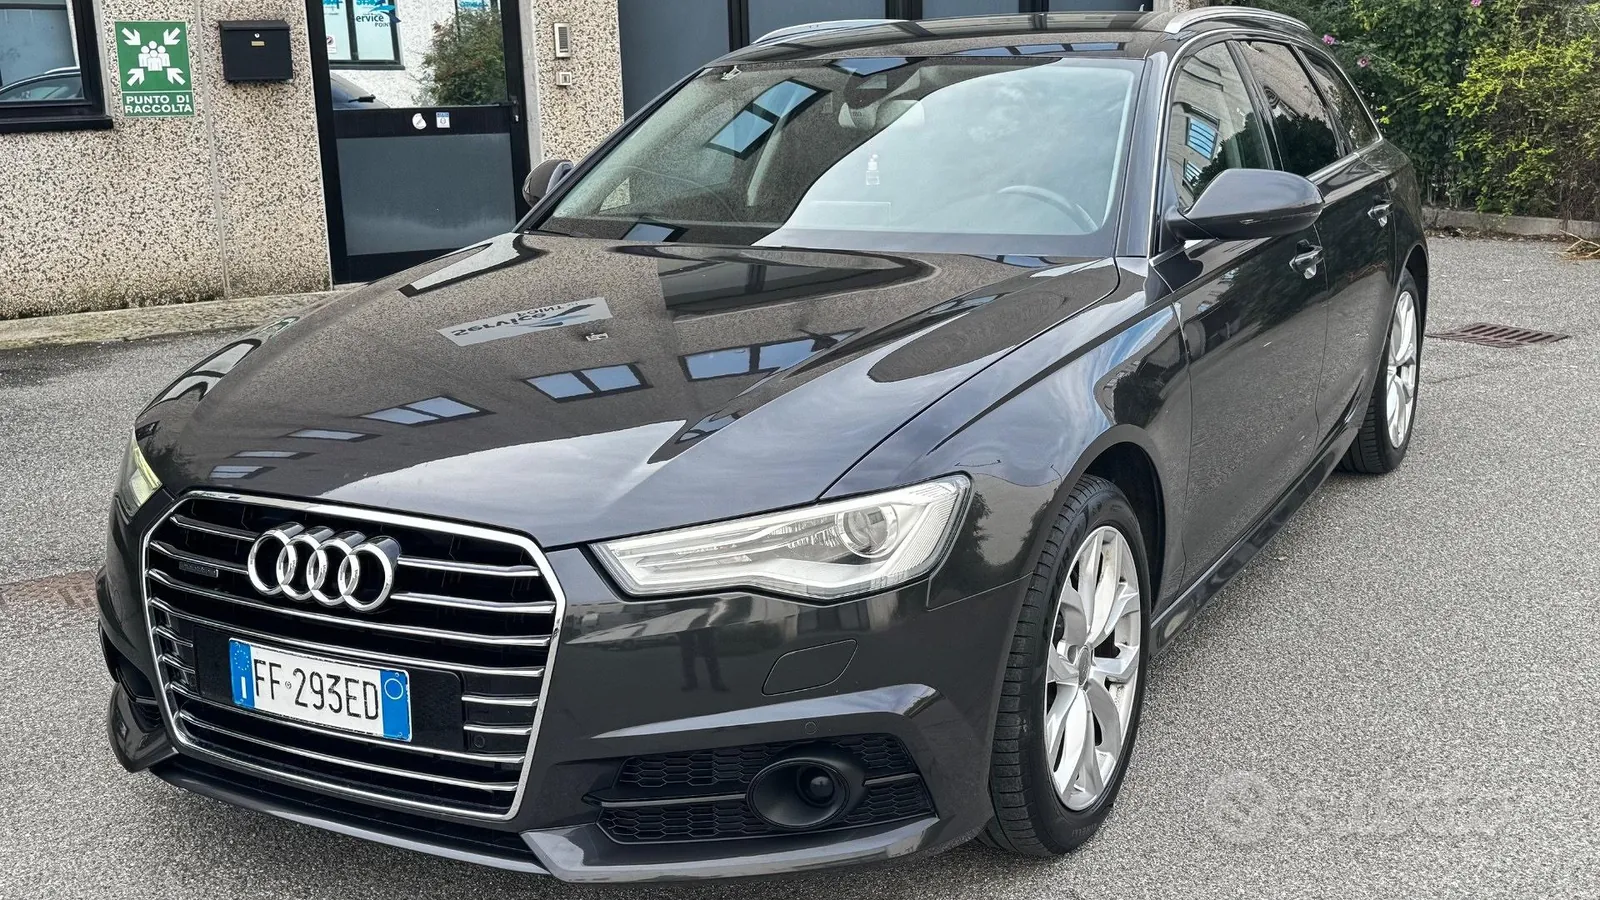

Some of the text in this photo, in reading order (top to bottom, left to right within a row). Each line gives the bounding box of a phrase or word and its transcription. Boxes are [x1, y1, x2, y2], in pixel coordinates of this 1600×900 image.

[126, 94, 190, 104] PUNTO DI
[125, 104, 193, 114] RACCOLTA
[292, 667, 380, 720] 293ED
